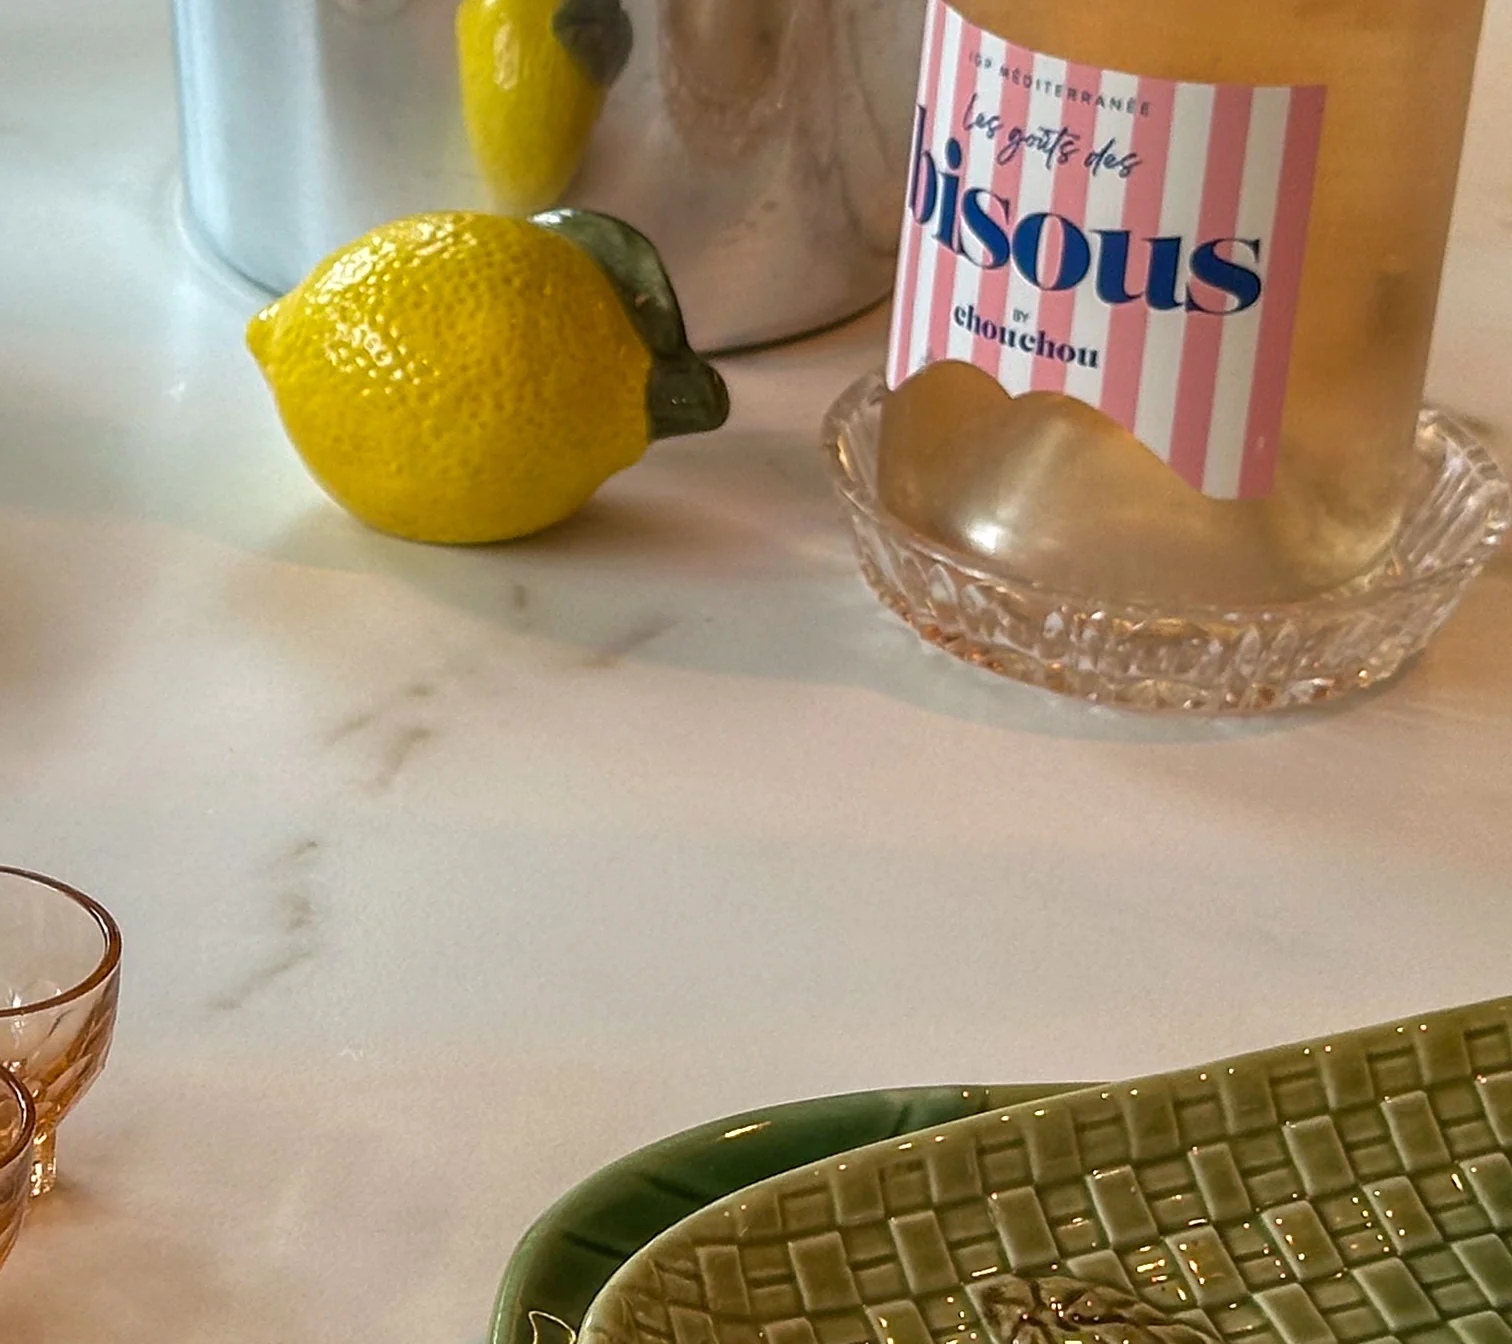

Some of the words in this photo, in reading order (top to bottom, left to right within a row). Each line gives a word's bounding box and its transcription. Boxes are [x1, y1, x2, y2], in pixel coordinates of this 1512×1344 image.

[1084, 138, 1142, 178] des
[908, 103, 1262, 315] bisous
[953, 305, 1098, 369] chouchou
